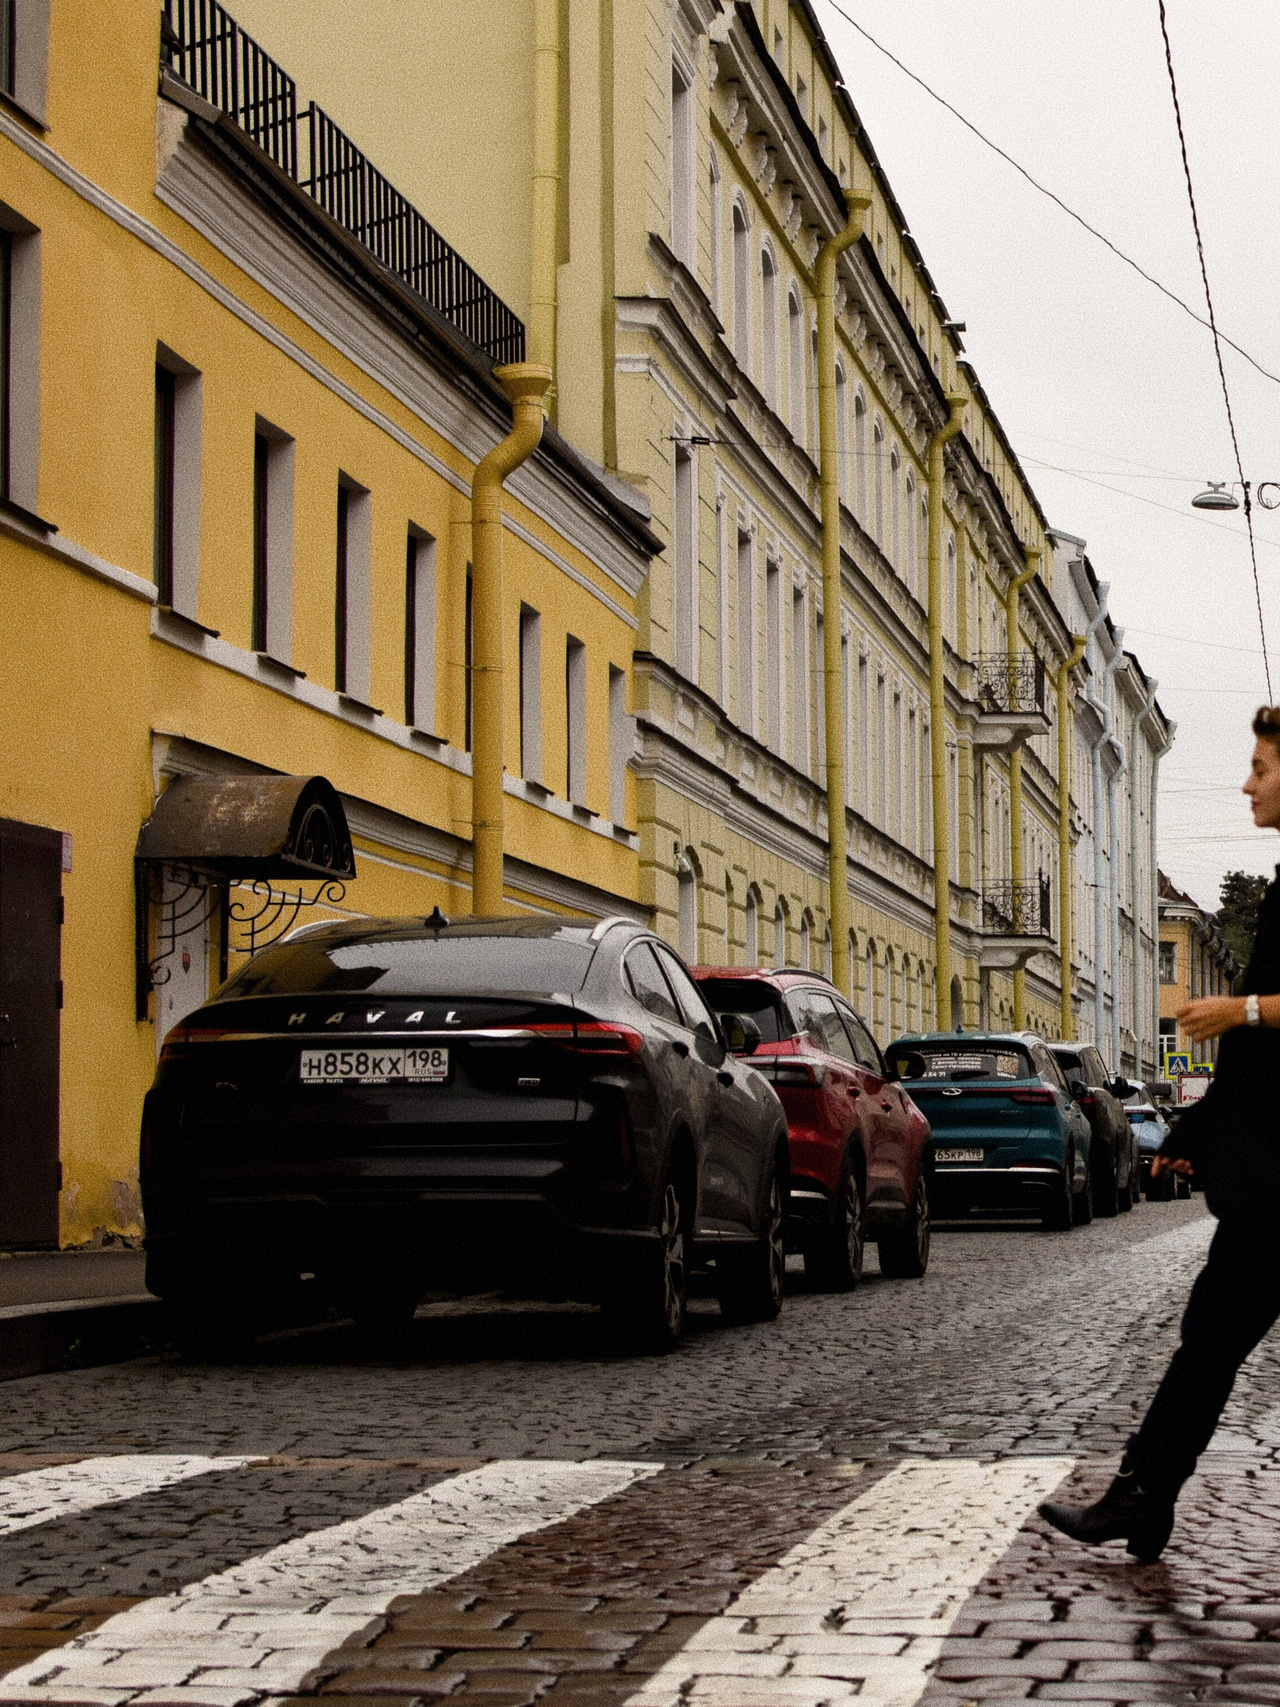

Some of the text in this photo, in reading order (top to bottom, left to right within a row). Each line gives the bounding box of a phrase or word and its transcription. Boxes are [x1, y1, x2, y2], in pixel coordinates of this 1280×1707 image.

[287, 1010, 462, 1026] HAVAL
[308, 1050, 443, 1076] Н858КХ 198
